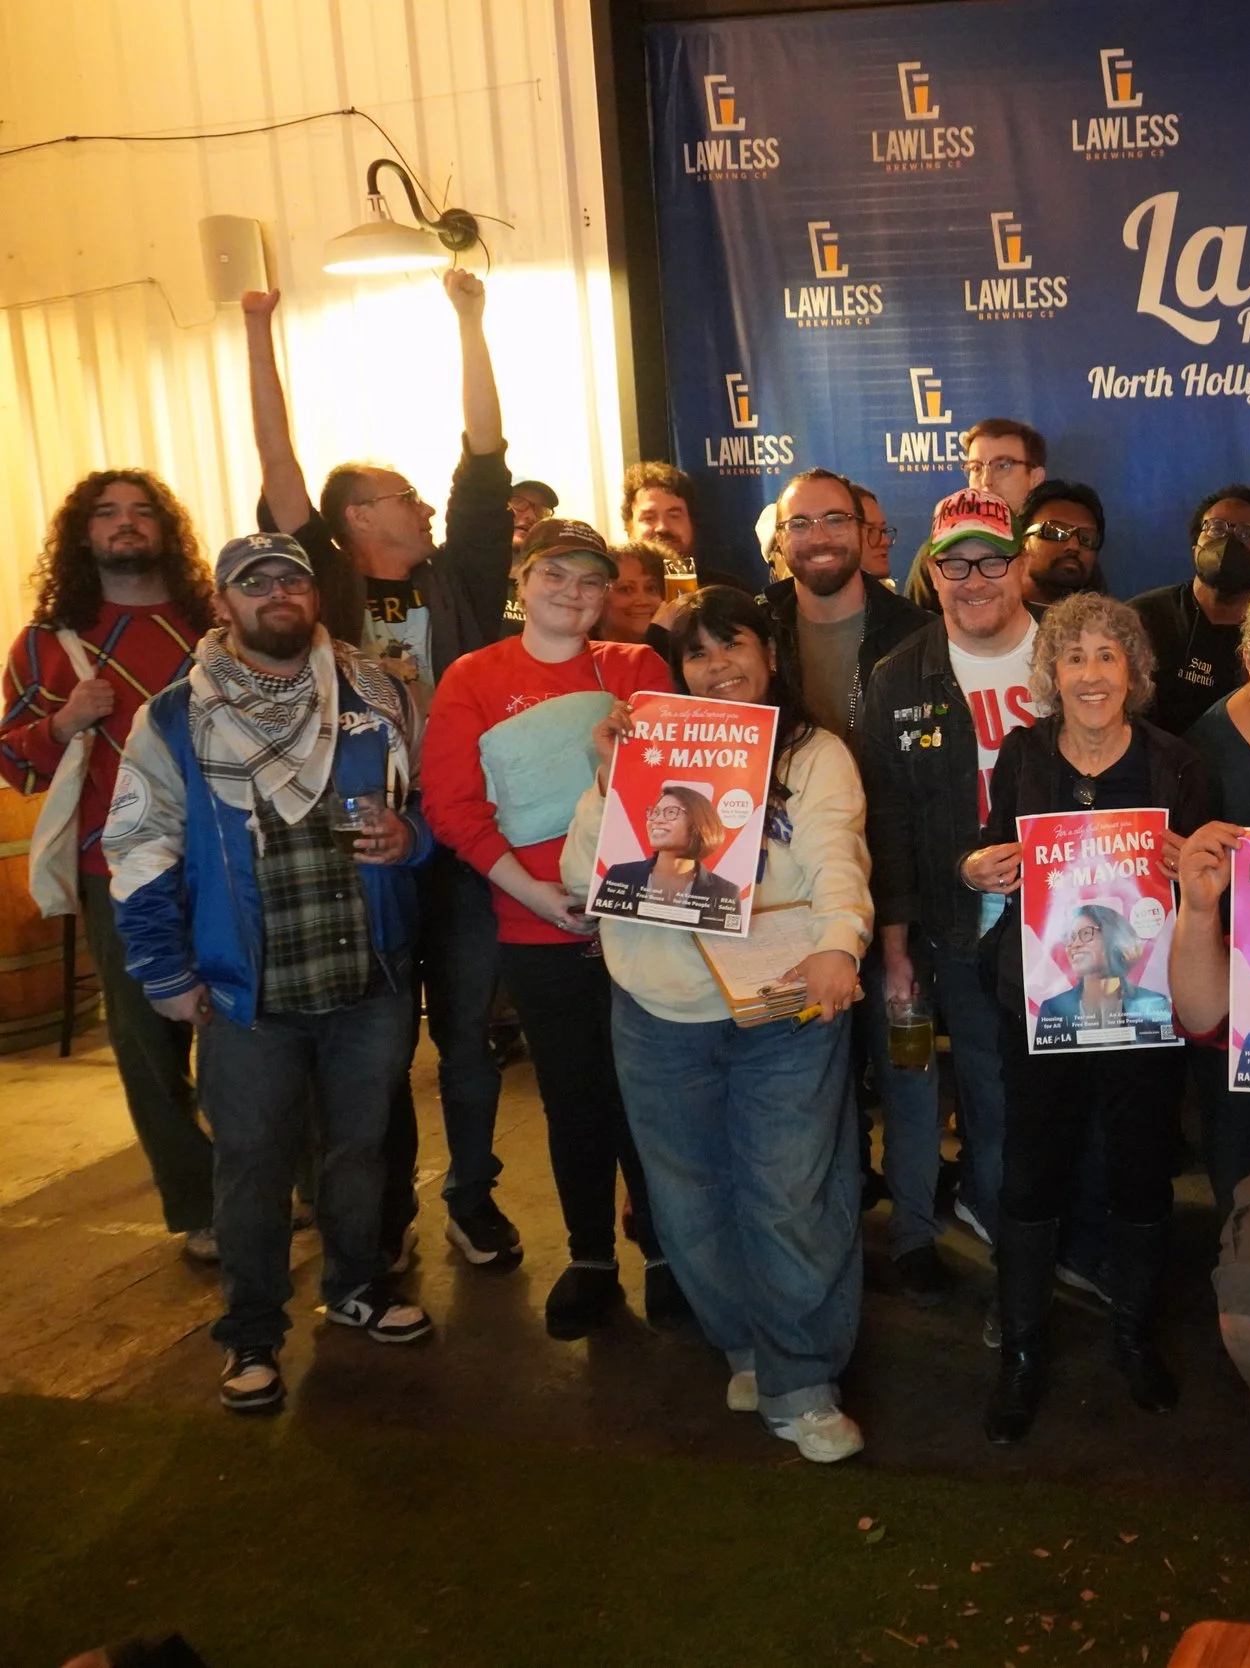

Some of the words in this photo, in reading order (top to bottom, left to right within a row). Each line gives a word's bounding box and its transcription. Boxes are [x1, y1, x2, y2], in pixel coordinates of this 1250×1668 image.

[1072, 114, 1179, 151] LAWLESS
[872, 126, 975, 162] LAWLESS
[684, 138, 780, 173] LAWLESS
[1086, 150, 1143, 160] BREWING
[697, 172, 746, 181] BREWING
[886, 162, 940, 171] BREWING
[784, 284, 883, 319] LAWLESS
[964, 276, 1068, 311] LAWLESS
[798, 318, 851, 327] BREWING
[979, 310, 1033, 321] BREWING
[1088, 366, 1173, 399] North
[706, 435, 794, 466] LAWLESS
[886, 431, 970, 463] LAWLES
[720, 466, 761, 475] BREWING
[899, 464, 952, 472] BREWING
[982, 500, 1009, 526] ICE
[1189, 658, 1212, 674] Stay
[635, 721, 678, 741] RAE
[683, 723, 759, 744] HUANG
[668, 748, 748, 768] MAYOR
[723, 800, 749, 808] VOTE!
[1036, 842, 1076, 865] RAE
[1081, 831, 1154, 858] HUANG
[1073, 857, 1150, 886] MAYOR
[595, 899, 612, 909] RAE
[622, 901, 633, 910] LA
[1036, 1035, 1053, 1045] RAE
[1061, 1034, 1071, 1042] LA
